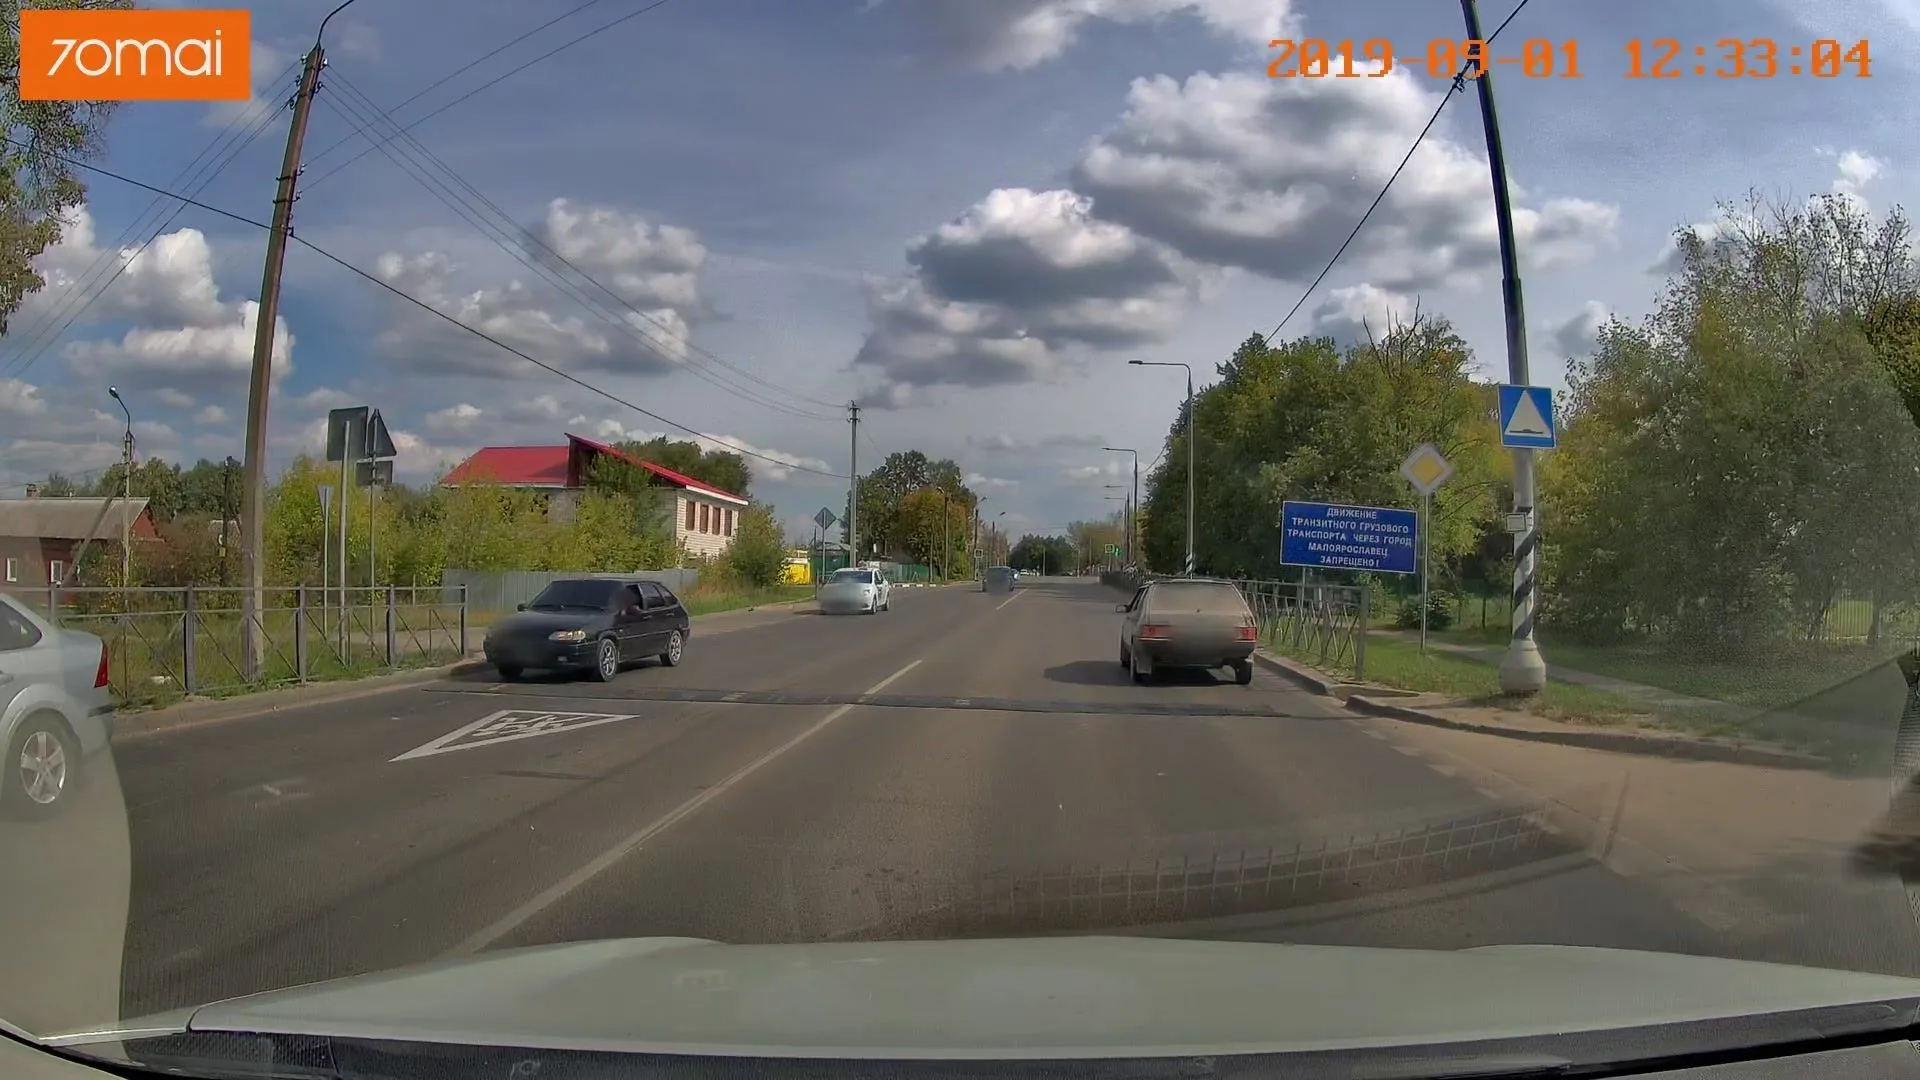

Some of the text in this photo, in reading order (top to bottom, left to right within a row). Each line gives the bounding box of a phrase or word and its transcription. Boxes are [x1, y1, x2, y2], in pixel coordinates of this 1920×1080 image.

[1326, 507, 1377, 519] ДВИЖЕНИЕ
[1291, 517, 1409, 534] ТРАНЗИТНОГО ГРУЗОВОГО
[1287, 529, 1412, 548] ТРАНСПОРТА ЧЕРЕЗ ГОРОД
[1308, 542, 1388, 558] МАЛОЯРОСЛАВЕЦ
